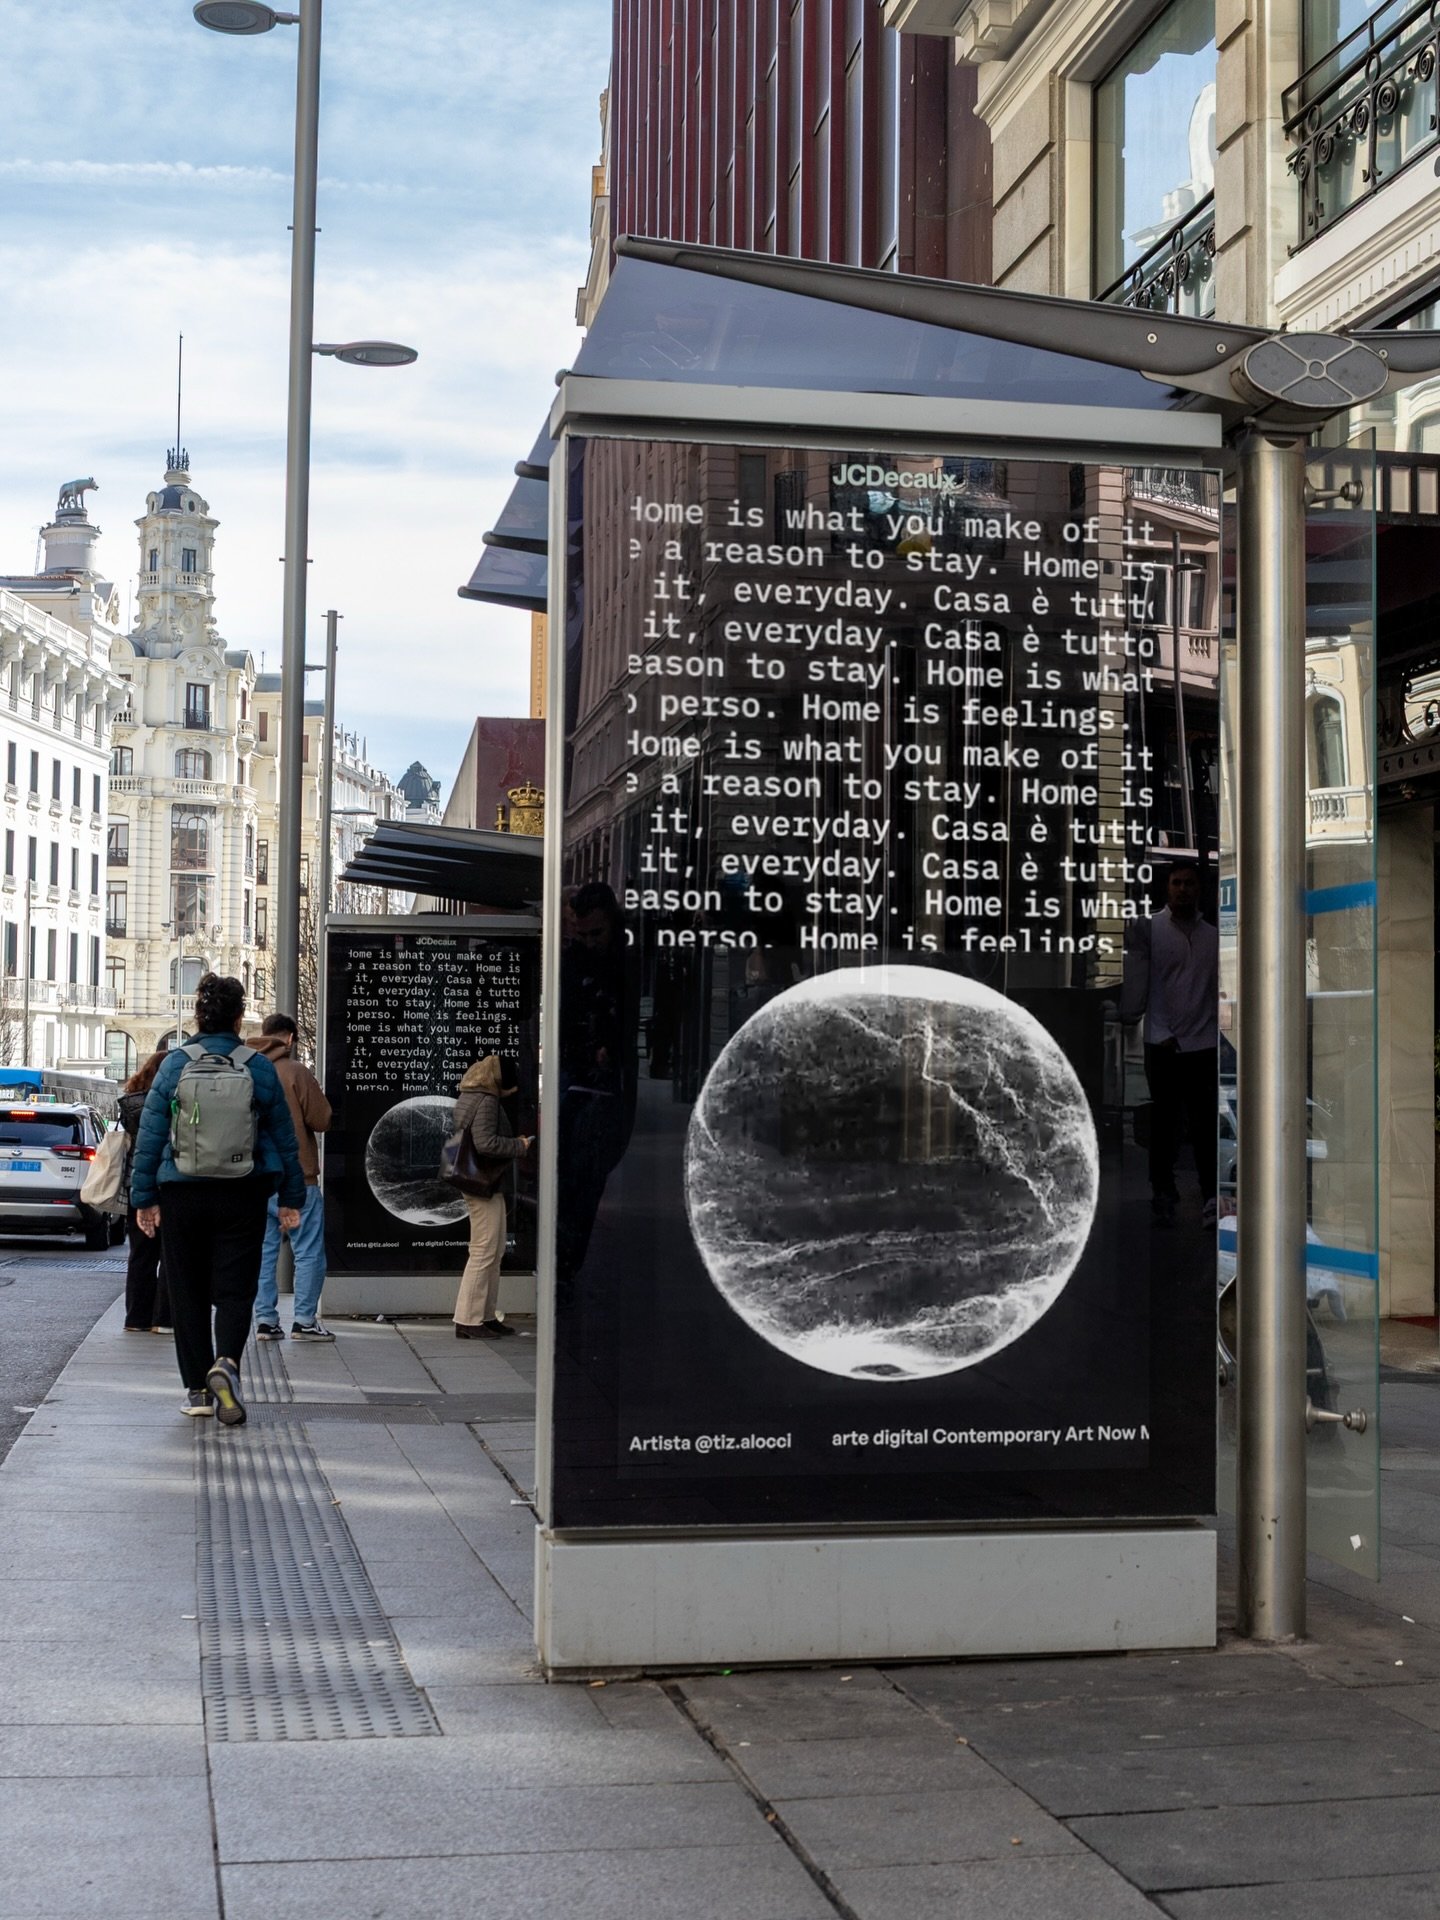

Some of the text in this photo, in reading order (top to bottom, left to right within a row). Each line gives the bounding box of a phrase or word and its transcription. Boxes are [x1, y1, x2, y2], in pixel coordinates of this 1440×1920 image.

[832, 463, 957, 490] JCDecaux
[728, 499, 764, 527] is
[786, 503, 864, 531] what
[887, 515, 943, 540] you
[965, 513, 1041, 540] make
[1063, 517, 1099, 542] of
[1121, 520, 1155, 547] it
[665, 541, 682, 560] a
[706, 539, 823, 566] reason
[846, 544, 884, 569] to
[907, 547, 996, 580] stay.
[1024, 551, 1098, 578] Home
[1122, 554, 1155, 582] is
[654, 572, 705, 605] it,
[735, 580, 906, 614] everyday.
[935, 585, 1010, 613] Casa
[1032, 587, 1049, 614] è
[644, 613, 1153, 657] it, everyday. Casa è tutto
[628, 654, 1153, 692] eason to stay. Home is what
[661, 695, 774, 721] perso.
[804, 694, 880, 721] Home
[904, 698, 939, 723] is
[962, 699, 1130, 736] feelings.
[725, 730, 761, 759] is
[784, 734, 861, 762] what
[885, 744, 940, 769] you
[964, 741, 1039, 767] make
[1062, 743, 1098, 769] of
[1121, 744, 1153, 771] it
[662, 773, 679, 793] a
[704, 771, 820, 797] reason
[844, 774, 881, 799] to
[905, 776, 994, 808] stay.
[1023, 779, 1097, 805] Home
[1120, 780, 1152, 807] is
[651, 806, 702, 838] it,
[732, 811, 904, 844] everyday.
[932, 815, 1009, 841] Casa
[1031, 815, 1047, 842] è
[641, 847, 1152, 883] it, everyday. Casa è tutto
[625, 886, 1152, 920] eason to stay. Home is what
[416, 937, 456, 945] JCDecaux
[801, 926, 877, 949] Home
[903, 928, 937, 951] is
[380, 950, 391, 958] is
[399, 950, 424, 959] what
[432, 953, 450, 962] you
[457, 952, 482, 960] make
[490, 952, 501, 961] of
[509, 952, 519, 961] it
[419, 963, 431, 971] to
[438, 963, 467, 974] stay.
[477, 964, 501, 972] Home
[509, 965, 520, 973] is
[353, 986, 519, 998] it, everyday. Casa è tutto
[355, 973, 373, 985] it,
[382, 974, 438, 985] everyday.
[447, 975, 472, 984] Casa
[479, 975, 485, 984] è
[358, 1012, 395, 1020] perso.
[404, 1011, 429, 1019] Home
[456, 1011, 511, 1022] feelings.
[386, 998, 398, 1006] to
[406, 999, 435, 1009] stay.
[445, 999, 469, 1007] Home
[477, 1000, 488, 1008] is
[496, 1000, 519, 1008] what
[379, 1023, 390, 1032] is
[397, 1023, 423, 1032] what
[431, 1025, 449, 1035] you
[456, 1024, 481, 1033] make
[488, 1024, 500, 1033] of
[508, 1025, 519, 1033] it
[417, 1036, 429, 1044] to
[437, 1036, 466, 1047] stay.
[475, 1036, 500, 1044] Home
[508, 1037, 519, 1045] is
[352, 1059, 468, 1070] it, everyday. Casa
[355, 1047, 371, 1056] it,
[381, 1047, 437, 1058] everyday.
[446, 1048, 471, 1056] Casa
[478, 1049, 484, 1057] è
[405, 1072, 434, 1081] stay.
[629, 1436, 691, 1452] Artista
[695, 1433, 792, 1454] @tiz.alocci
[832, 1431, 870, 1446] arte
[873, 1428, 928, 1449] digital
[932, 1427, 1061, 1447] Contemporary
[1065, 1426, 1094, 1443] Art
[1098, 1425, 1133, 1442] Now
